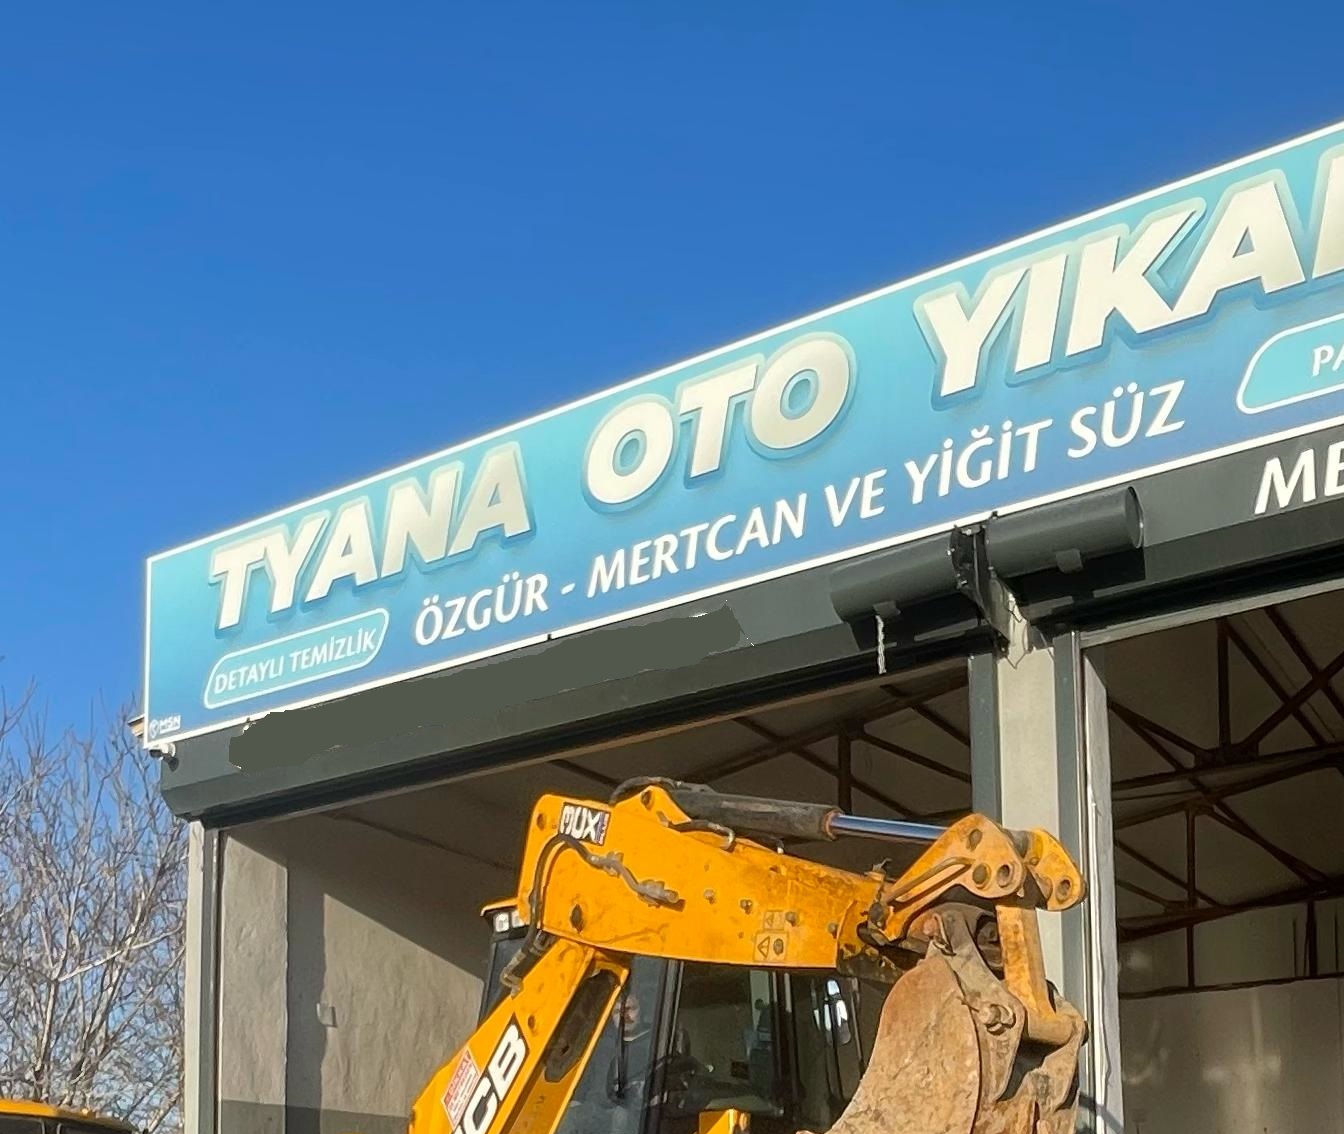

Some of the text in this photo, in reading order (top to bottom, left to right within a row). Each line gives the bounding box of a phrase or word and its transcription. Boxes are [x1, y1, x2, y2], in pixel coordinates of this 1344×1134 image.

[211, 450, 532, 631] TYANA
[586, 339, 850, 505] OTO
[414, 379, 1186, 647] ÖZGÜR - MERTCAN VE YİĞİT SÜZ
[214, 626, 377, 695] DETAYLI TEMİZLİK
